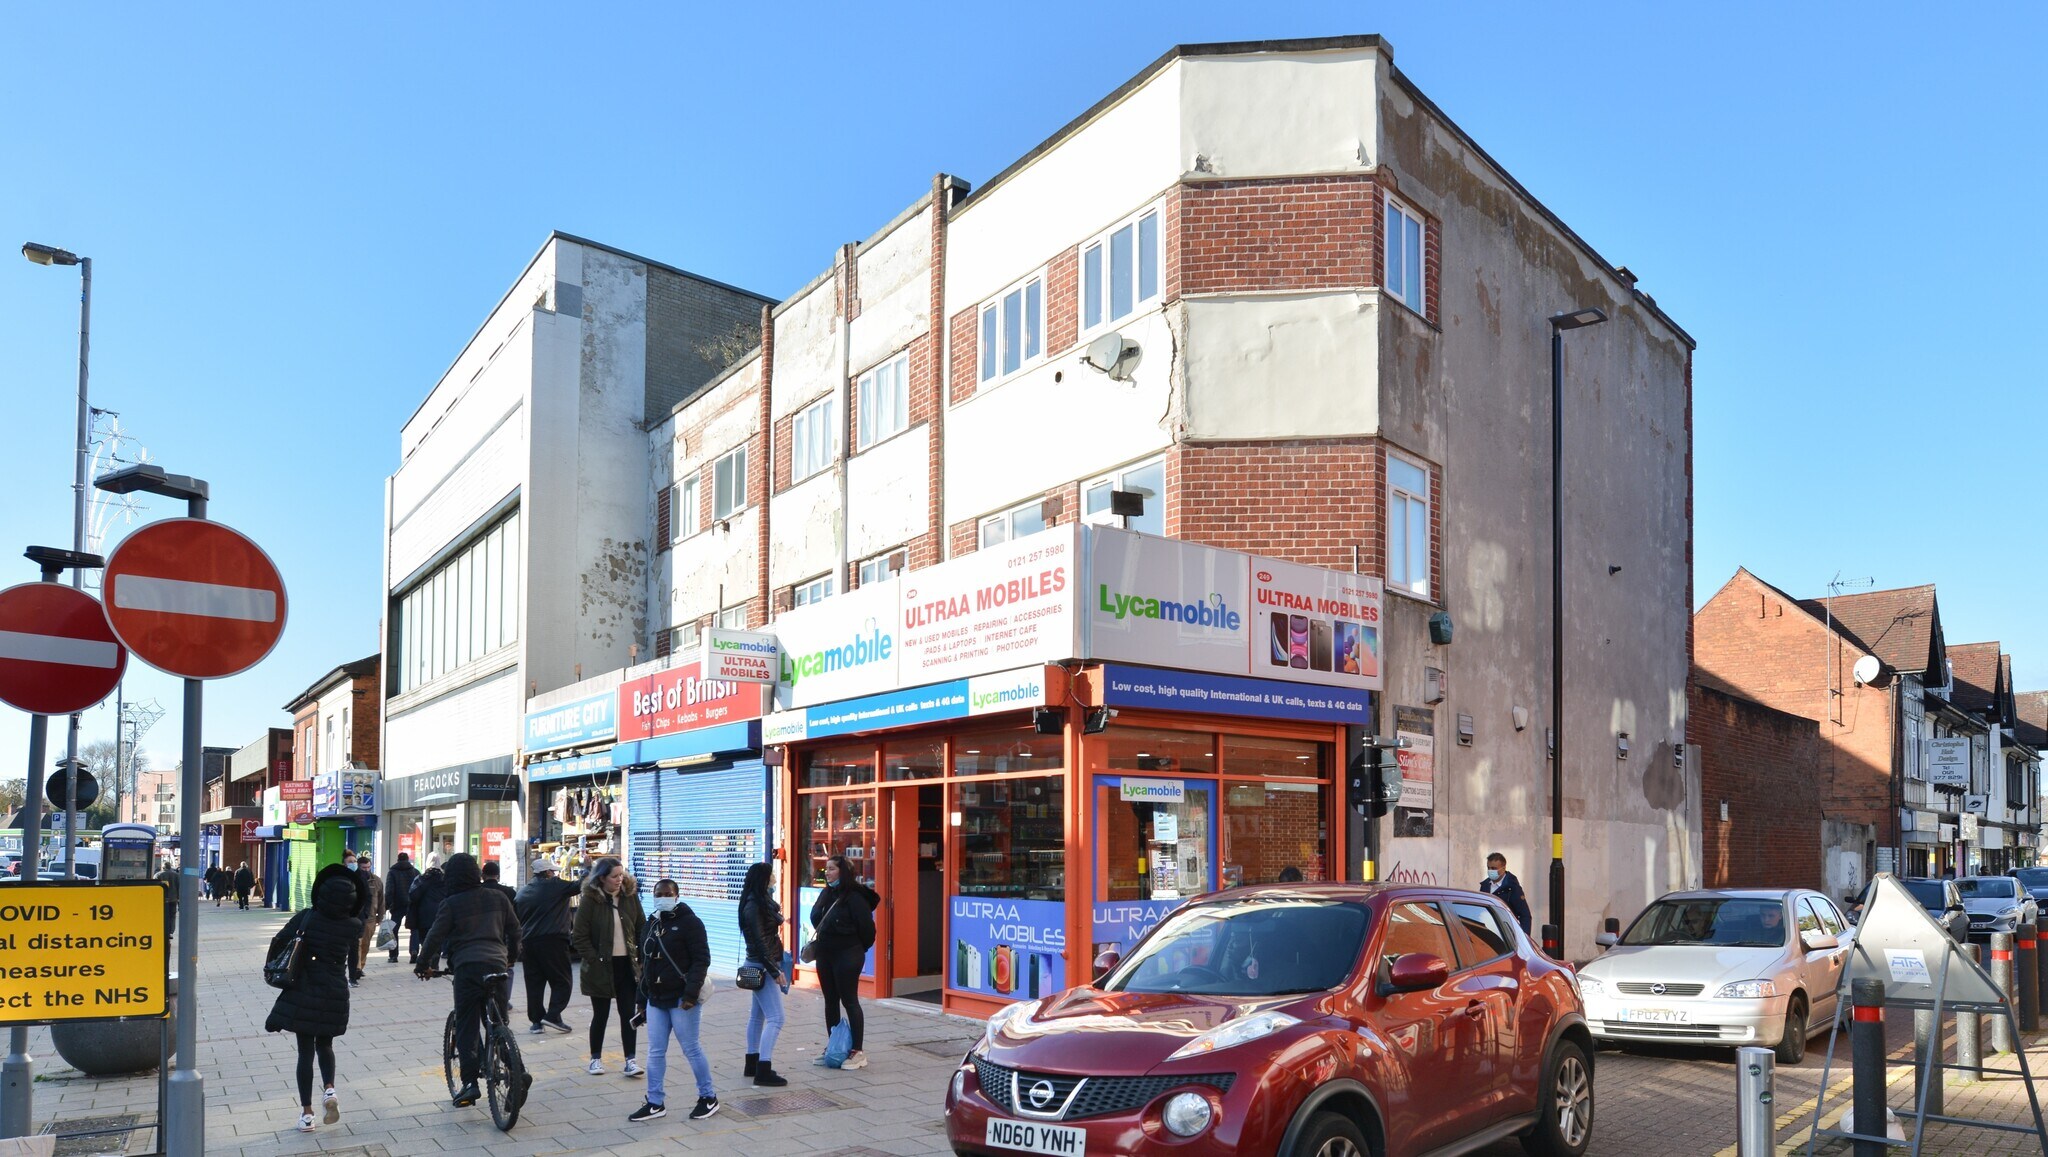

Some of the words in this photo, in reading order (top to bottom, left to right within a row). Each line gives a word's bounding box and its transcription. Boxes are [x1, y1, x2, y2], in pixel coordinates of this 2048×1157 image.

[1008, 556, 1026, 568] 0121
[1029, 550, 1043, 562] 257
[1045, 543, 1065, 557] 5980
[1259, 572, 1271, 581] 249
[905, 594, 971, 629] ULTRAA
[976, 567, 1066, 612] MOBILES
[1355, 589, 1365, 597] 257
[1100, 584, 1240, 631] Lycamobile
[1257, 588, 1313, 612] ULTRAA
[1317, 598, 1378, 622] MOBILES
[905, 639, 917, 647] NEW
[924, 633, 940, 643] USED
[942, 626, 969, 639] MOBILES
[973, 617, 1008, 632] REPAIRING
[1013, 604, 1063, 623] ACCESSORIES
[949, 637, 977, 650] LAPTOPS
[984, 628, 1017, 643] INTERNET
[1019, 624, 1037, 635] CAFE
[713, 638, 777, 653] Lycamobile
[922, 656, 952, 668] SCANNING
[960, 647, 989, 660] PRINTING
[996, 637, 1038, 653] PHOTOCOPY
[724, 656, 766, 668] ULTRAA
[780, 628, 892, 688] Lycamobile
[720, 667, 770, 679] MOBILES
[634, 684, 663, 717] Best
[666, 678, 683, 710] of
[973, 683, 1040, 708] Lycamobile
[1112, 680, 1132, 691] Low
[1134, 684, 1156, 695] cost,
[1158, 685, 1178, 697] high
[1179, 688, 1209, 700] quality
[1210, 689, 1262, 703] International
[1264, 695, 1270, 704] &
[1272, 695, 1284, 704] UK
[1285, 696, 1306, 708] calls,
[1307, 698, 1326, 708] texts
[1327, 700, 1333, 709] &
[1334, 701, 1345, 710] 4G
[1346, 701, 1363, 711] data
[529, 706, 580, 738] FURNITURE
[583, 698, 609, 726] CITY
[655, 717, 671, 729] Chips
[677, 712, 698, 724] Kebabs
[705, 706, 728, 720] Burgers
[764, 721, 804, 740] Lycamobile
[414, 771, 460, 792] PEACOCKS
[1123, 783, 1182, 797] Lycamobile
[0, 905, 61, 921] OVID
[89, 904, 114, 921] 19
[954, 901, 1021, 922] ULTRAA
[1092, 906, 1172, 924] ULTRAA
[0, 934, 17, 950] al
[28, 932, 152, 951] distancing
[989, 923, 1066, 946] MOBILES
[44, 990, 85, 1006] the
[95, 986, 149, 1005] NHS
[1629, 1008, 1660, 1021] FP02
[1664, 1010, 1687, 1022] VYZ
[992, 1121, 1035, 1148] ND60
[1040, 1128, 1076, 1153] YNH
